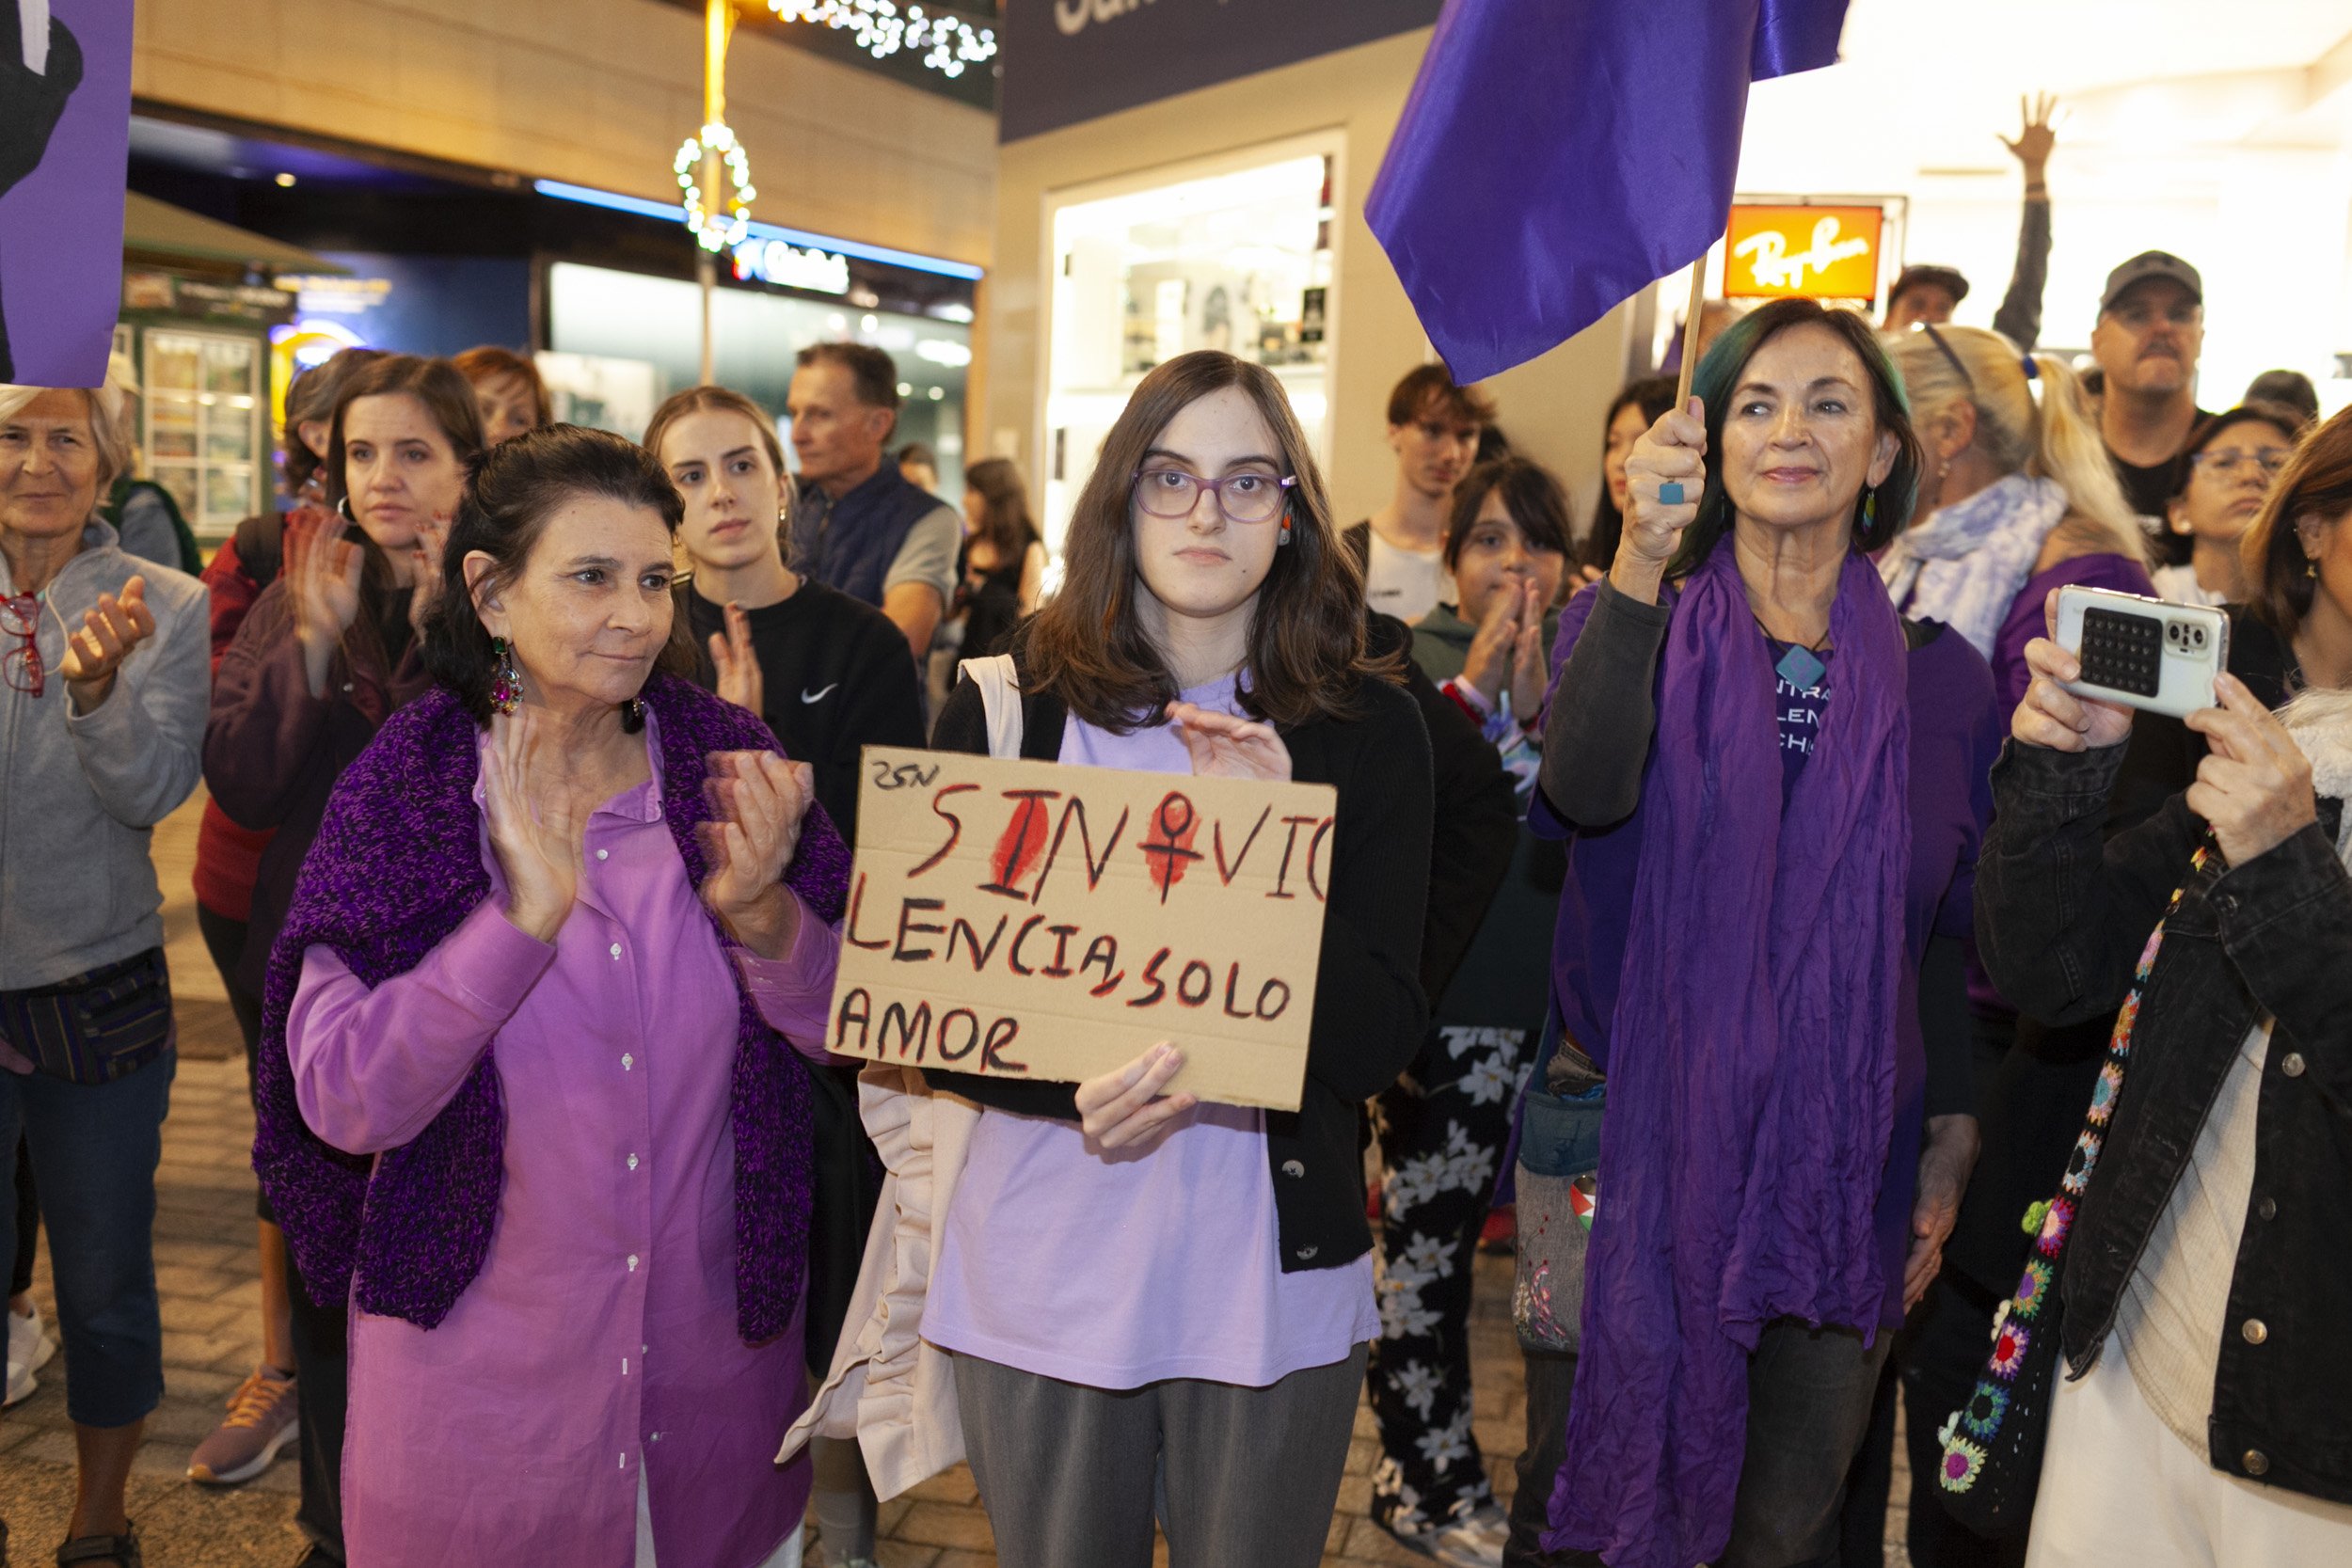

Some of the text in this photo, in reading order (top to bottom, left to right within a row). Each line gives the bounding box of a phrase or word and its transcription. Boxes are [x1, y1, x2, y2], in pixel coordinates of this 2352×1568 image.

[872, 760, 940, 790] 25N
[907, 784, 1129, 906] SIN
[834, 989, 1028, 1072] AMOR
